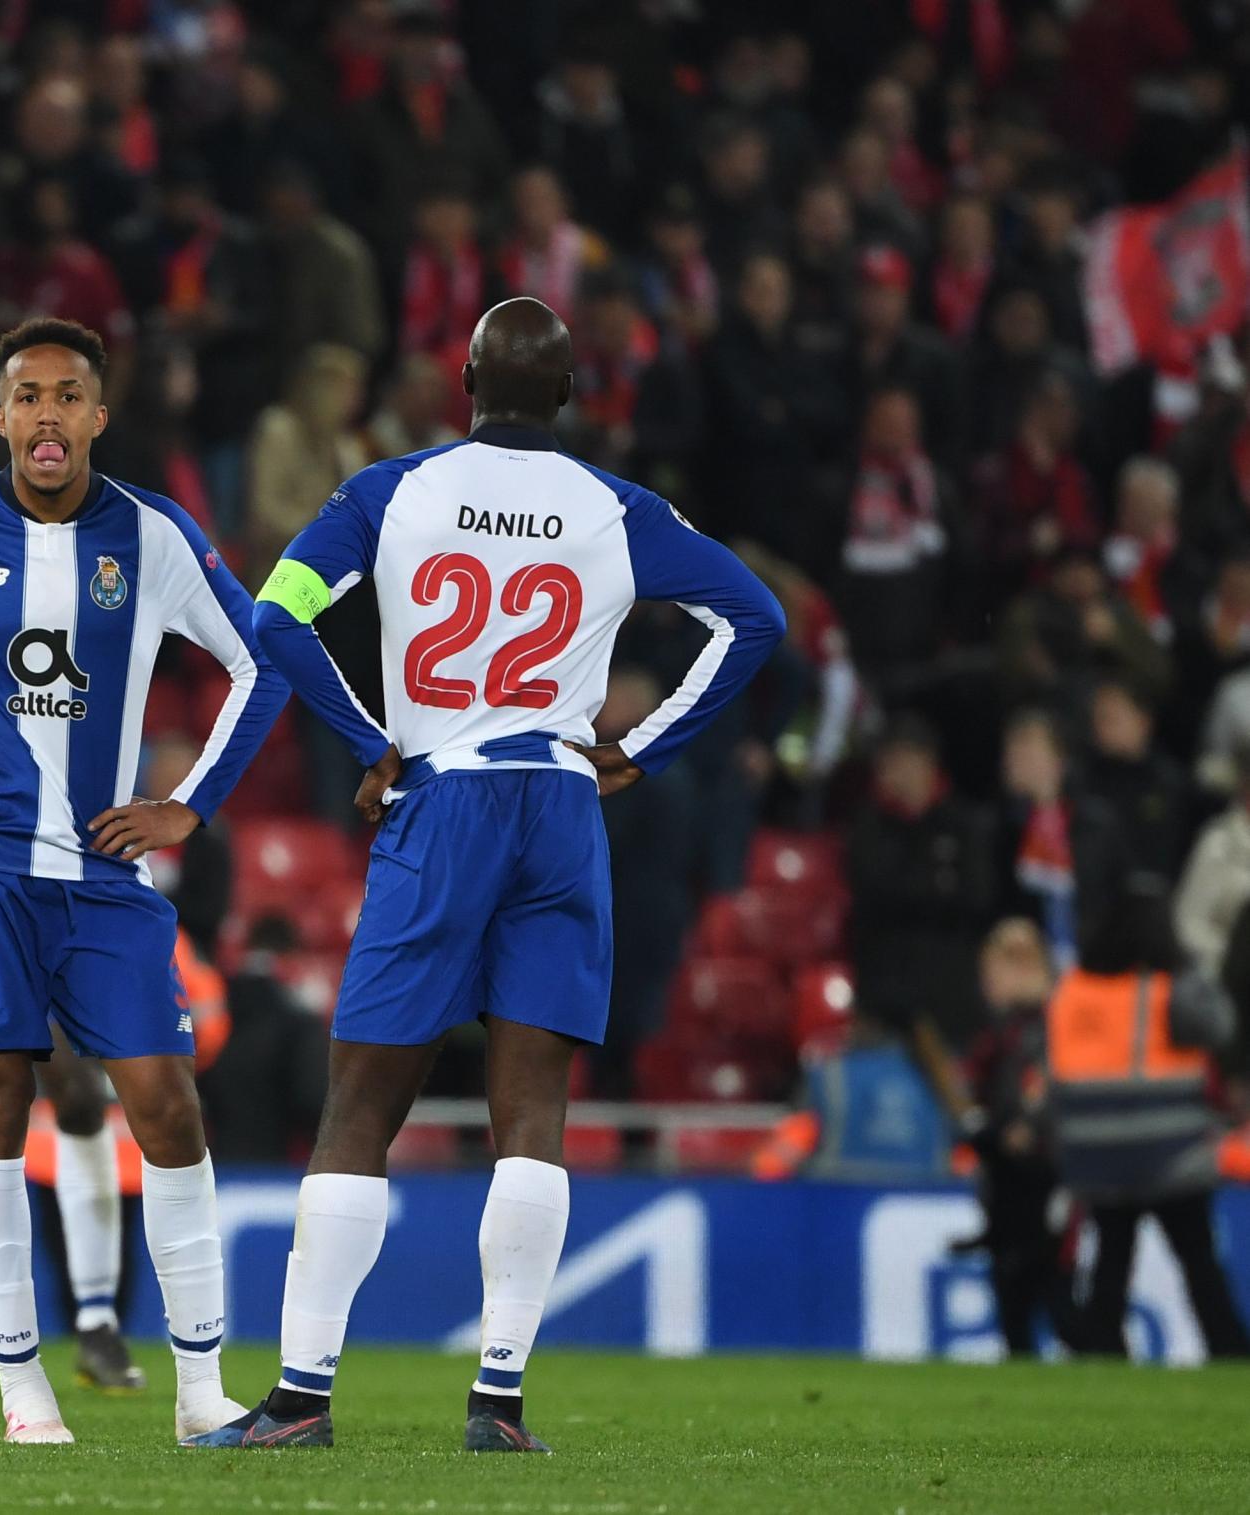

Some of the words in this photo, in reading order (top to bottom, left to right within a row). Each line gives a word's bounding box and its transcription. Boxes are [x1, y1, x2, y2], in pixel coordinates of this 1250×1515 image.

[458, 505, 563, 540] DANILO
[404, 552, 583, 710] 22
[7, 691, 87, 719] altice
